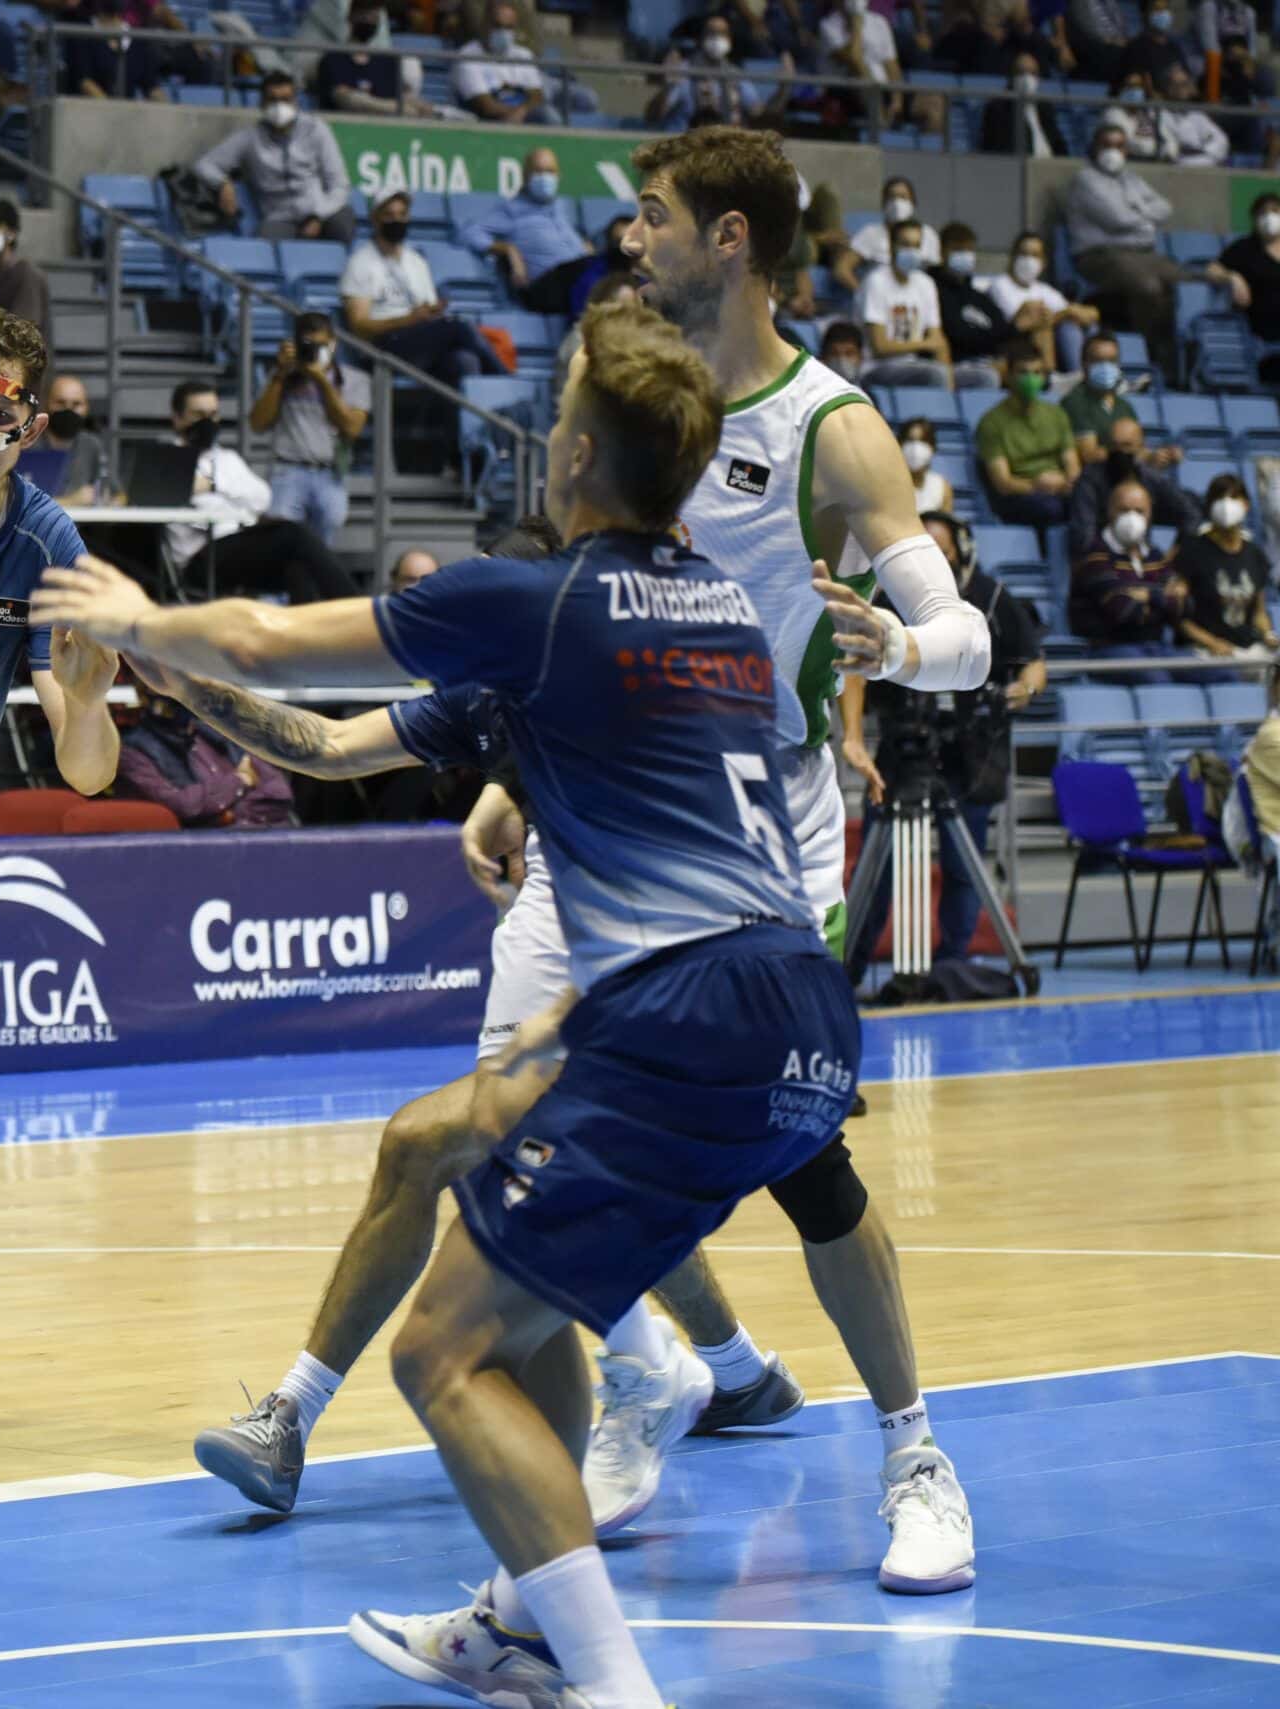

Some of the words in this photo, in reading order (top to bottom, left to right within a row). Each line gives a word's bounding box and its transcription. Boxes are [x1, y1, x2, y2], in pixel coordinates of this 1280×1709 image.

[357, 139, 470, 197] SAÍDA
[193, 962, 481, 1001] www.hormigonescarral.com
[19, 1026, 37, 1045] DE
[39, 1025, 92, 1044] GALICIA
